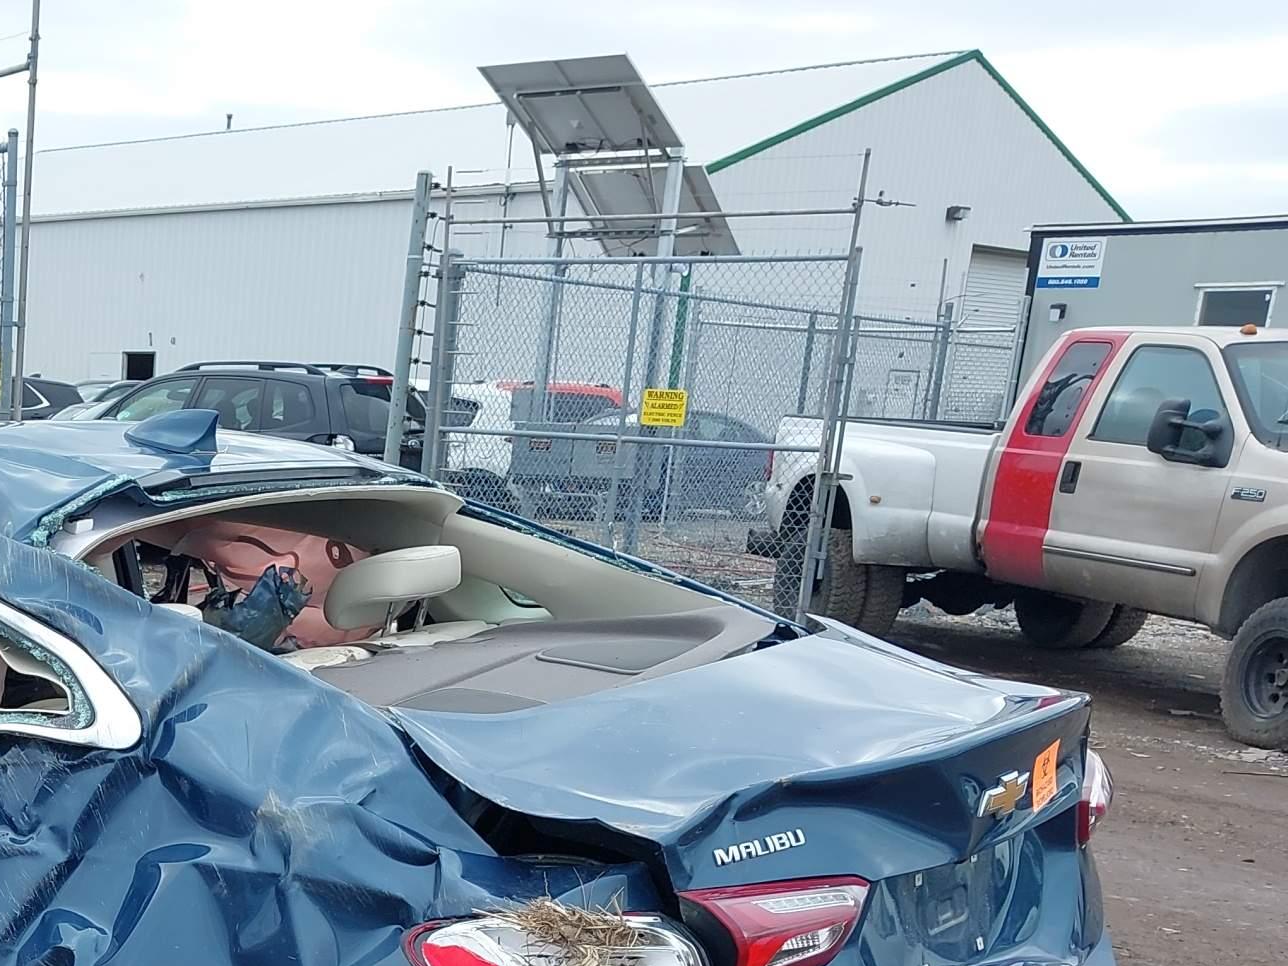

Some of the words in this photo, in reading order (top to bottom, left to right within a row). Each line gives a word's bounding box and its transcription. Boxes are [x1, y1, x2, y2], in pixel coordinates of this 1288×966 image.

[1070, 243, 1098, 251] United
[647, 390, 684, 400] WARNING
[713, 828, 806, 867] MALIBU
